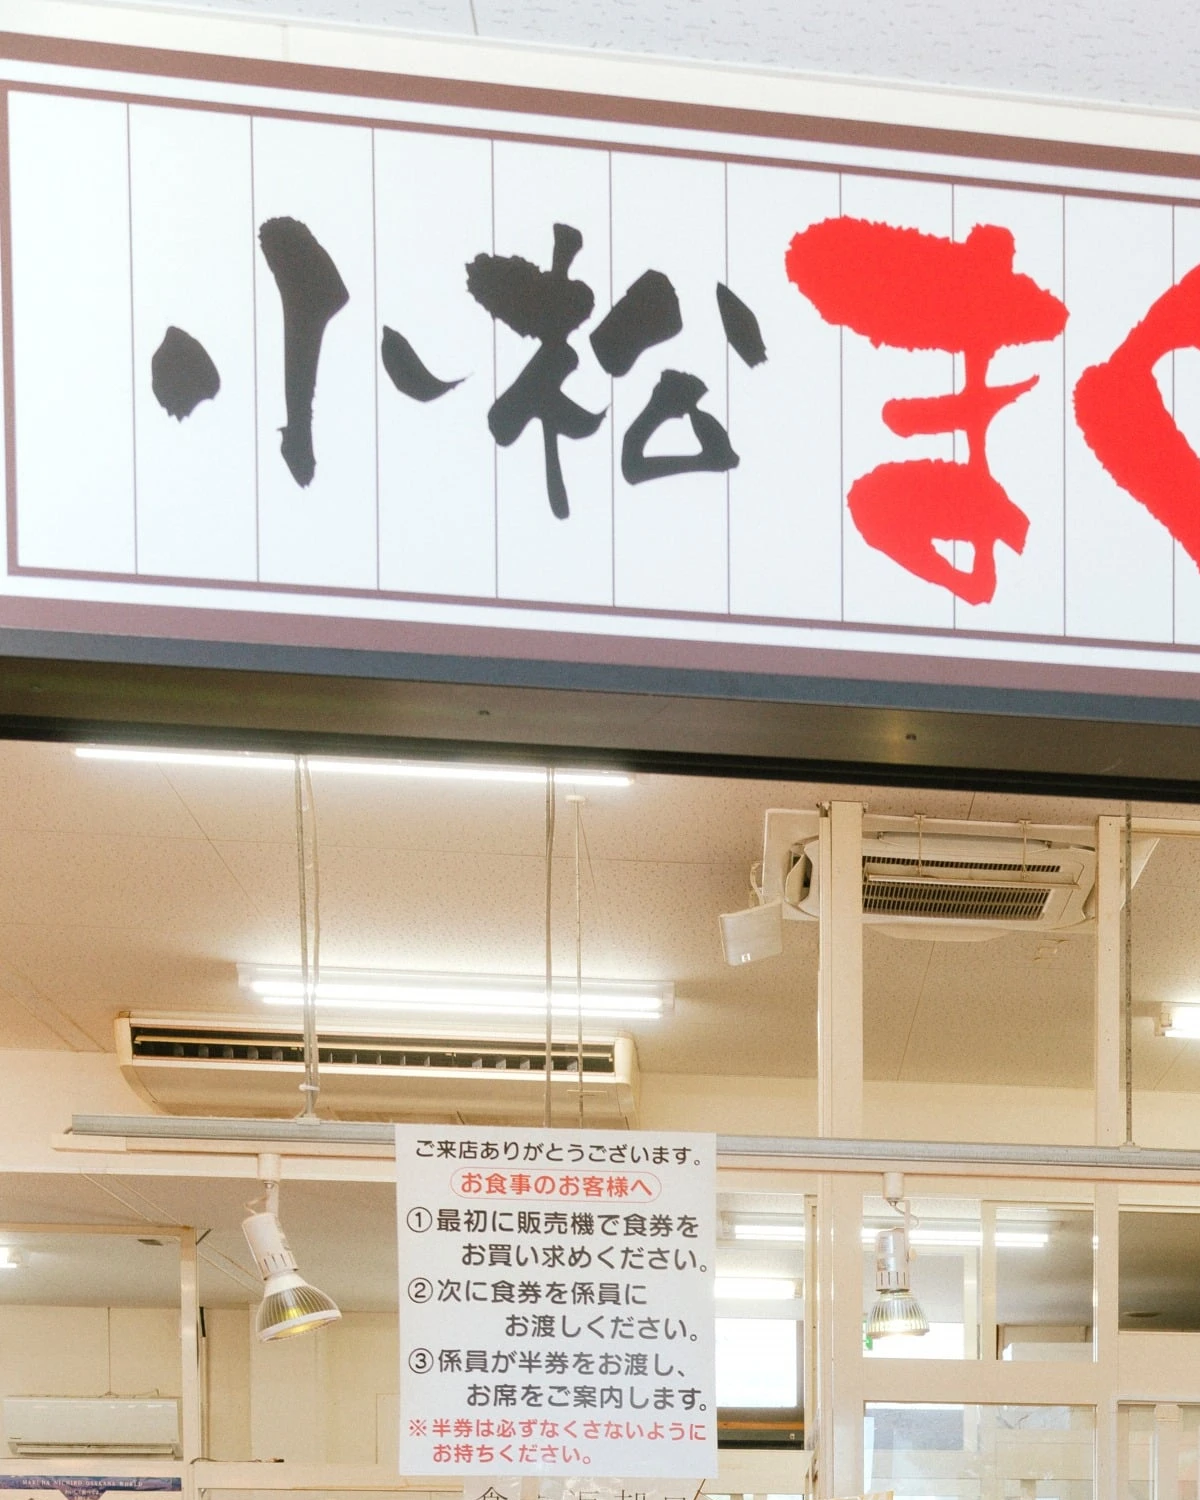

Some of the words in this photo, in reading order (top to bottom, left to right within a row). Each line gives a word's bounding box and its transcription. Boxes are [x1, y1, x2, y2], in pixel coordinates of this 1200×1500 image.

[415, 1139, 702, 1166] ご来店ありがとうございます。
[461, 1173, 653, 1197] お食事のお客様へ
[461, 1243, 708, 1273] お買い求めください。
[505, 1314, 699, 1342] お渡しください。
[467, 1384, 707, 1413] お席をご案内します。
[432, 1444, 594, 1465] お持ちください。
